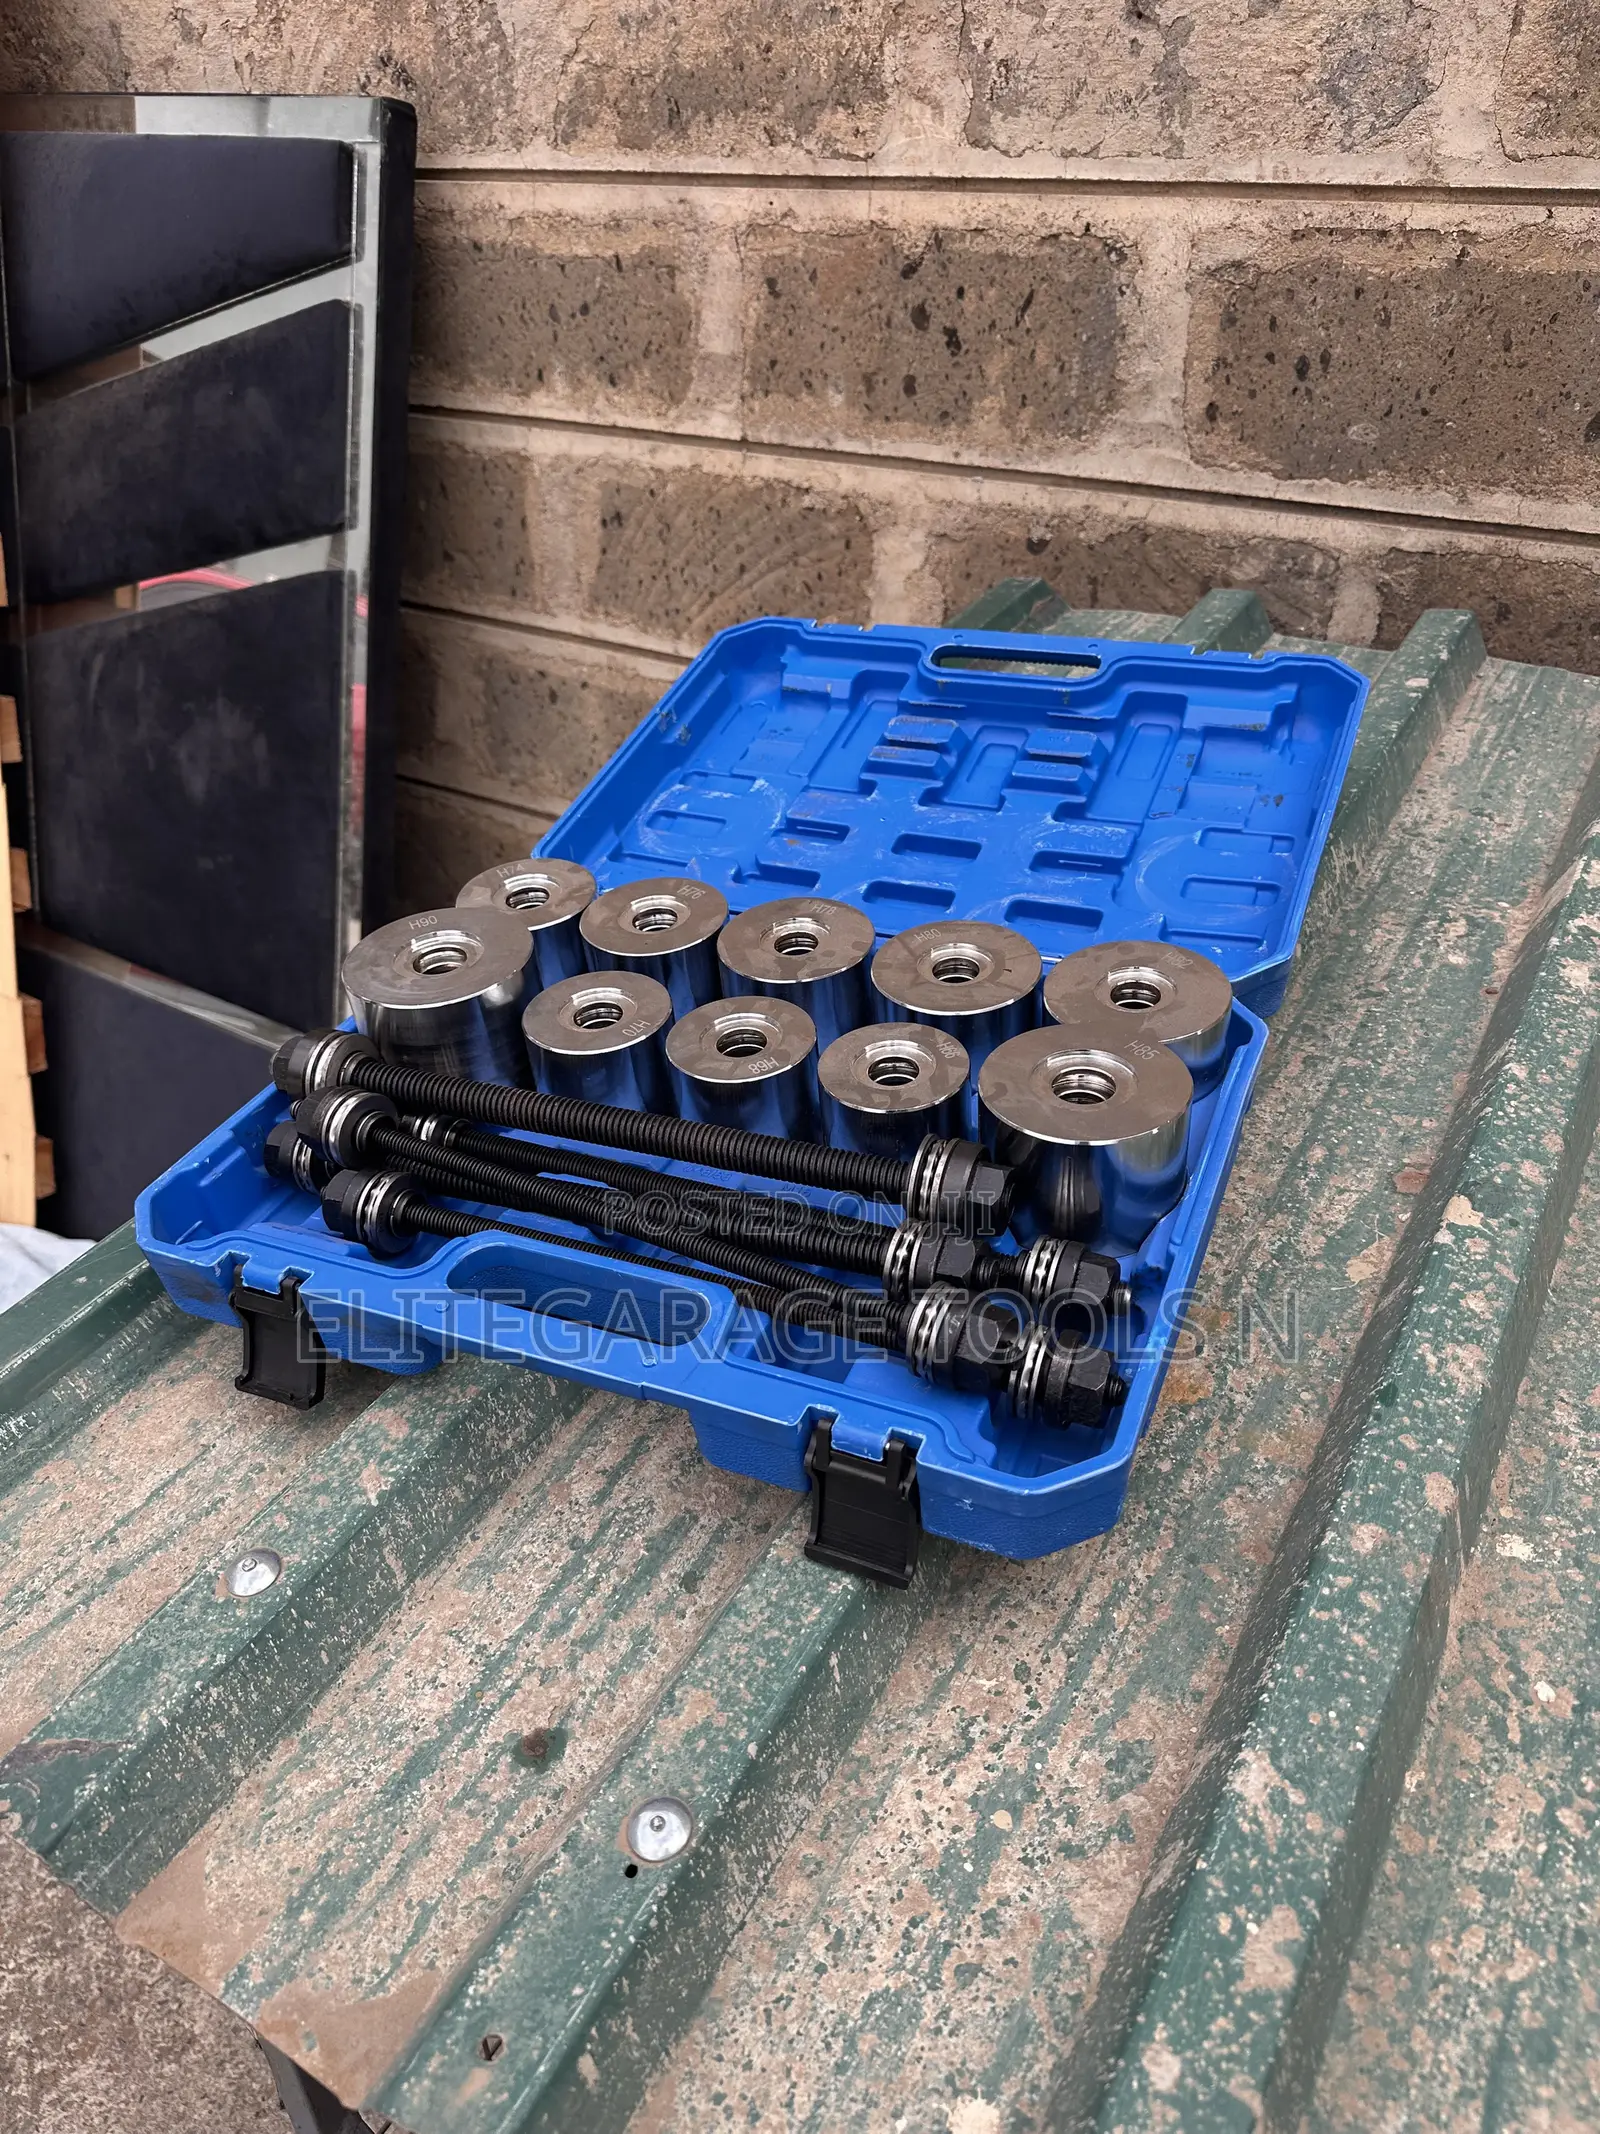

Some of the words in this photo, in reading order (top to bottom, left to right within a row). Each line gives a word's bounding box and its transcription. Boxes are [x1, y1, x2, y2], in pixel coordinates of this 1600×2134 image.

[496, 863, 525, 878] H74
[676, 884, 707, 901] H76
[811, 903, 836, 916] H78
[408, 915, 438, 930] H90
[914, 928, 942, 943] H80
[1161, 951, 1194, 970] H82
[621, 1018, 652, 1038] H70
[1123, 1039, 1161, 1061] H85
[748, 1056, 780, 1075] H68
